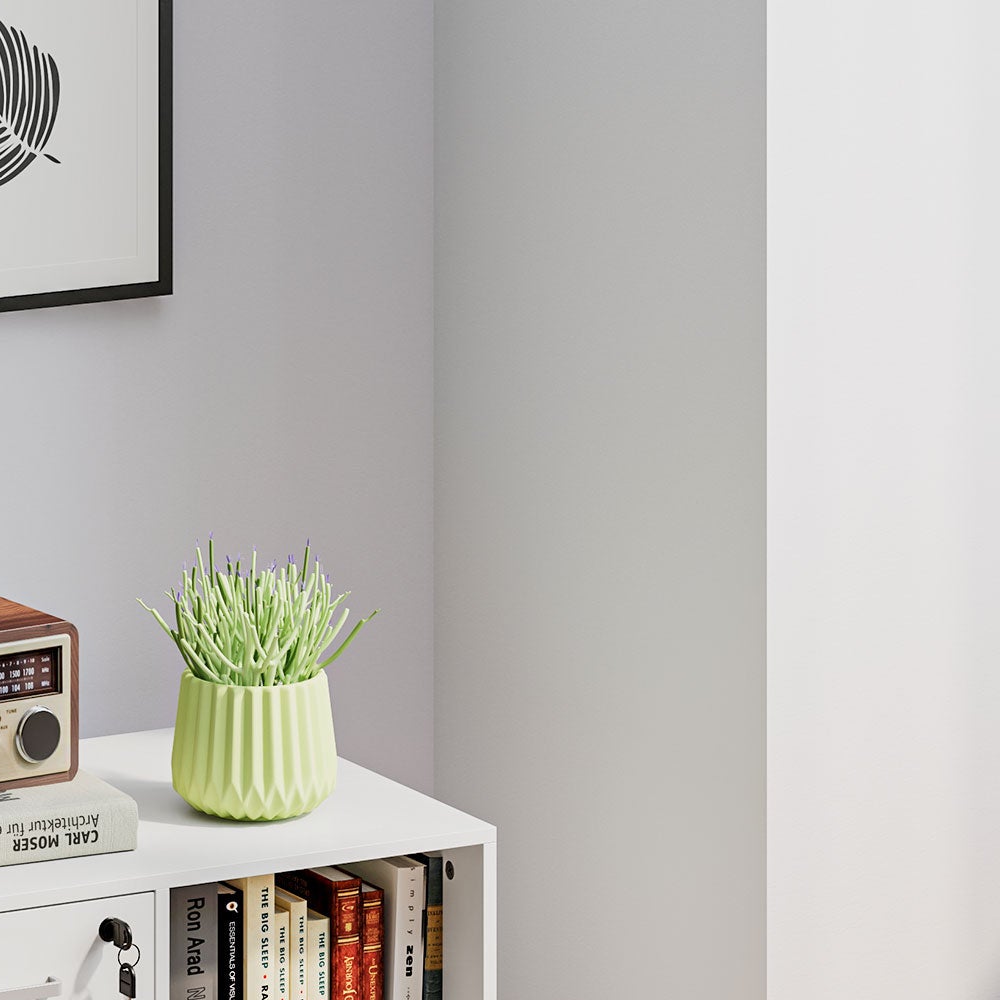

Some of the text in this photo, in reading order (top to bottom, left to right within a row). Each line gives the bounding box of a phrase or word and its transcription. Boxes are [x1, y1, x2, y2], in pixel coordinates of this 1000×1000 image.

[9, 670, 21, 678] 1500
[22, 667, 34, 676] 1700
[0, 685, 9, 694] 100
[11, 684, 21, 692] 104
[24, 682, 34, 690] 108
[6, 822, 24, 837] für
[28, 813, 100, 833] Architektur
[12, 829, 99, 852] CARL MOSER
[261, 887, 269, 908] THE
[261, 913, 269, 933] BIG
[187, 897, 205, 976] Ron Arad
[228, 921, 236, 970] ESSENTIALS
[261, 937, 269, 968] SLEEP
[405, 945, 414, 977] zen
[228, 970, 236, 982] OF
